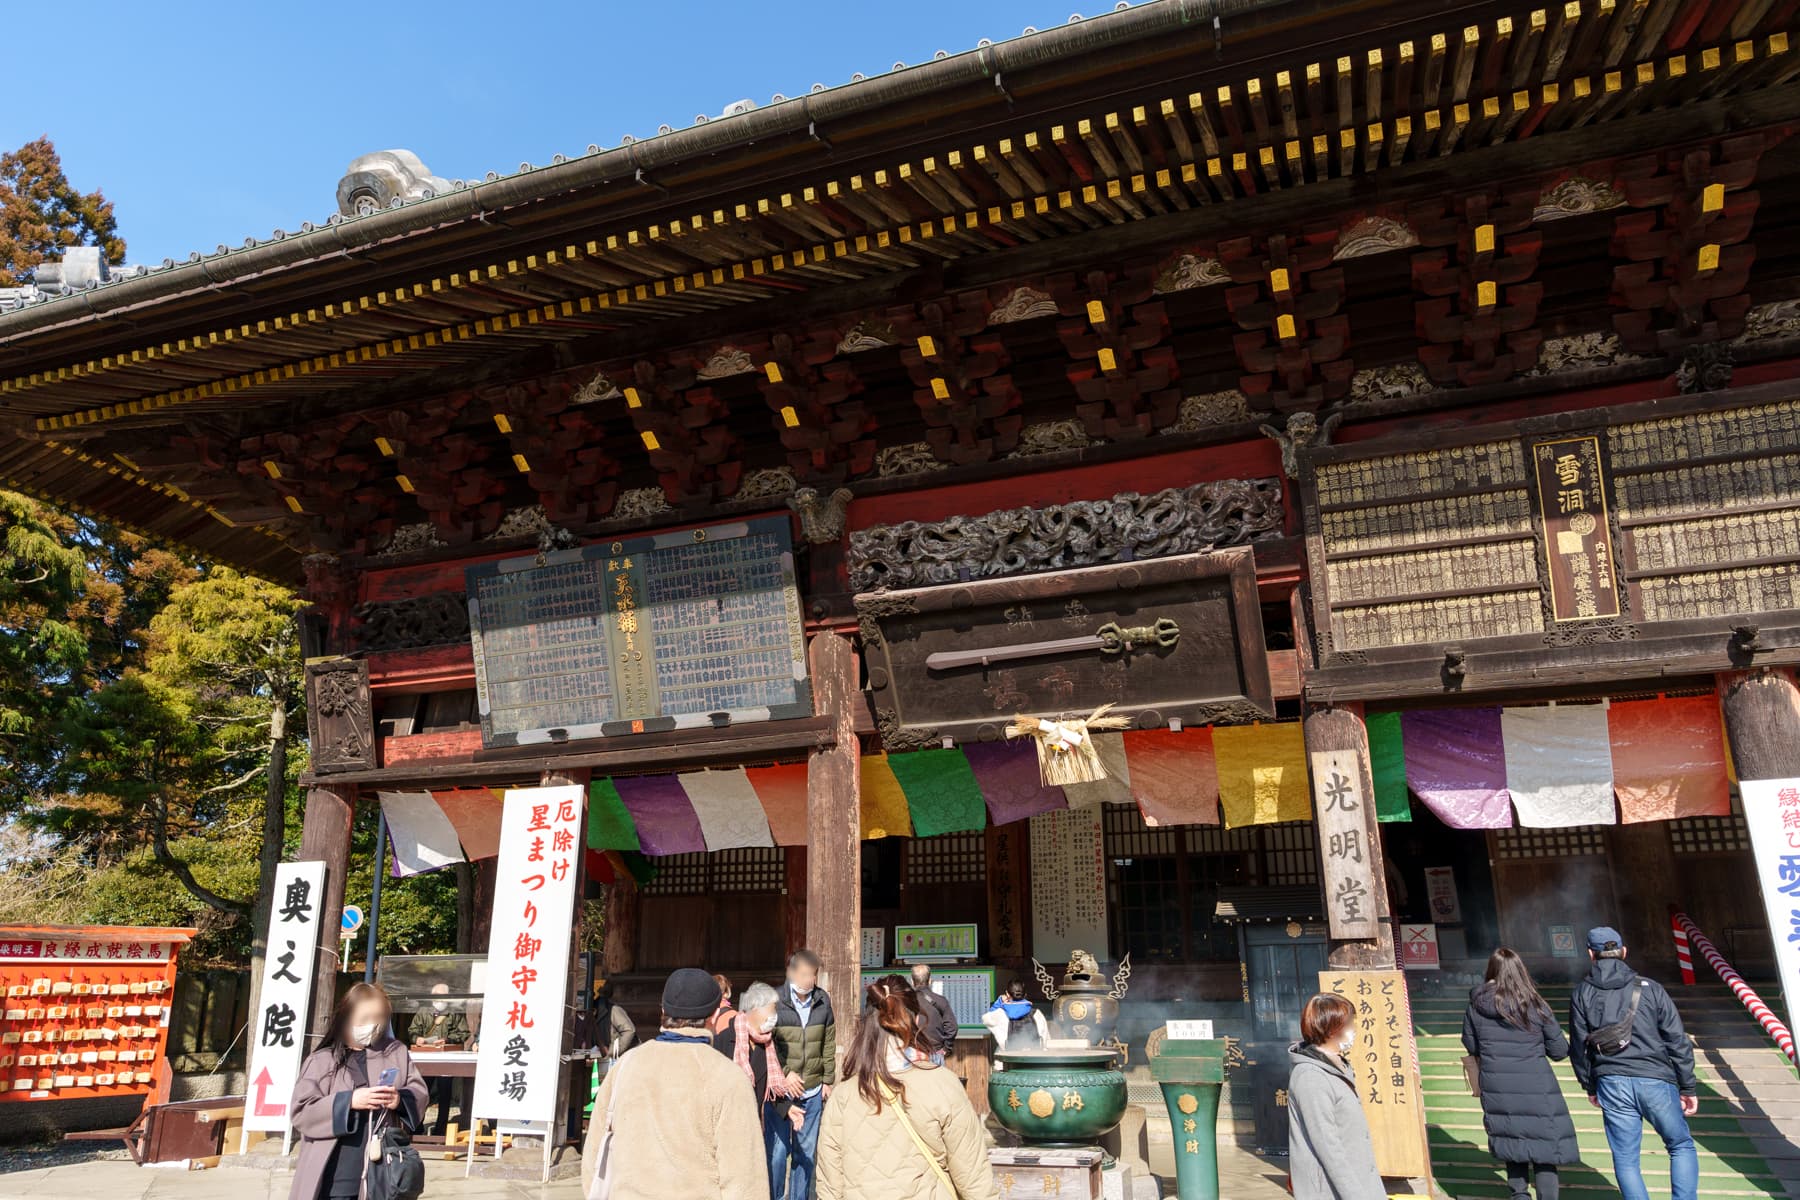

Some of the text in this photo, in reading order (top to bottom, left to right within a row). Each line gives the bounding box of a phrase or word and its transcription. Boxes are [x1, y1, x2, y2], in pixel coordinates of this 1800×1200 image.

[1555, 453, 1584, 513] 雪洞
[551, 799, 577, 881] 厄除け
[1324, 772, 1368, 925] 光明堂
[44, 941, 162, 959] 良縁成就絵馬
[262, 877, 313, 1048] 奥之院
[498, 804, 552, 1102] 星まつり御守札受場
[1008, 1089, 1085, 1112] 奉 納
[1357, 978, 1384, 1105] おあがりのうえ
[1381, 979, 1407, 1105] どうぞご自由に
